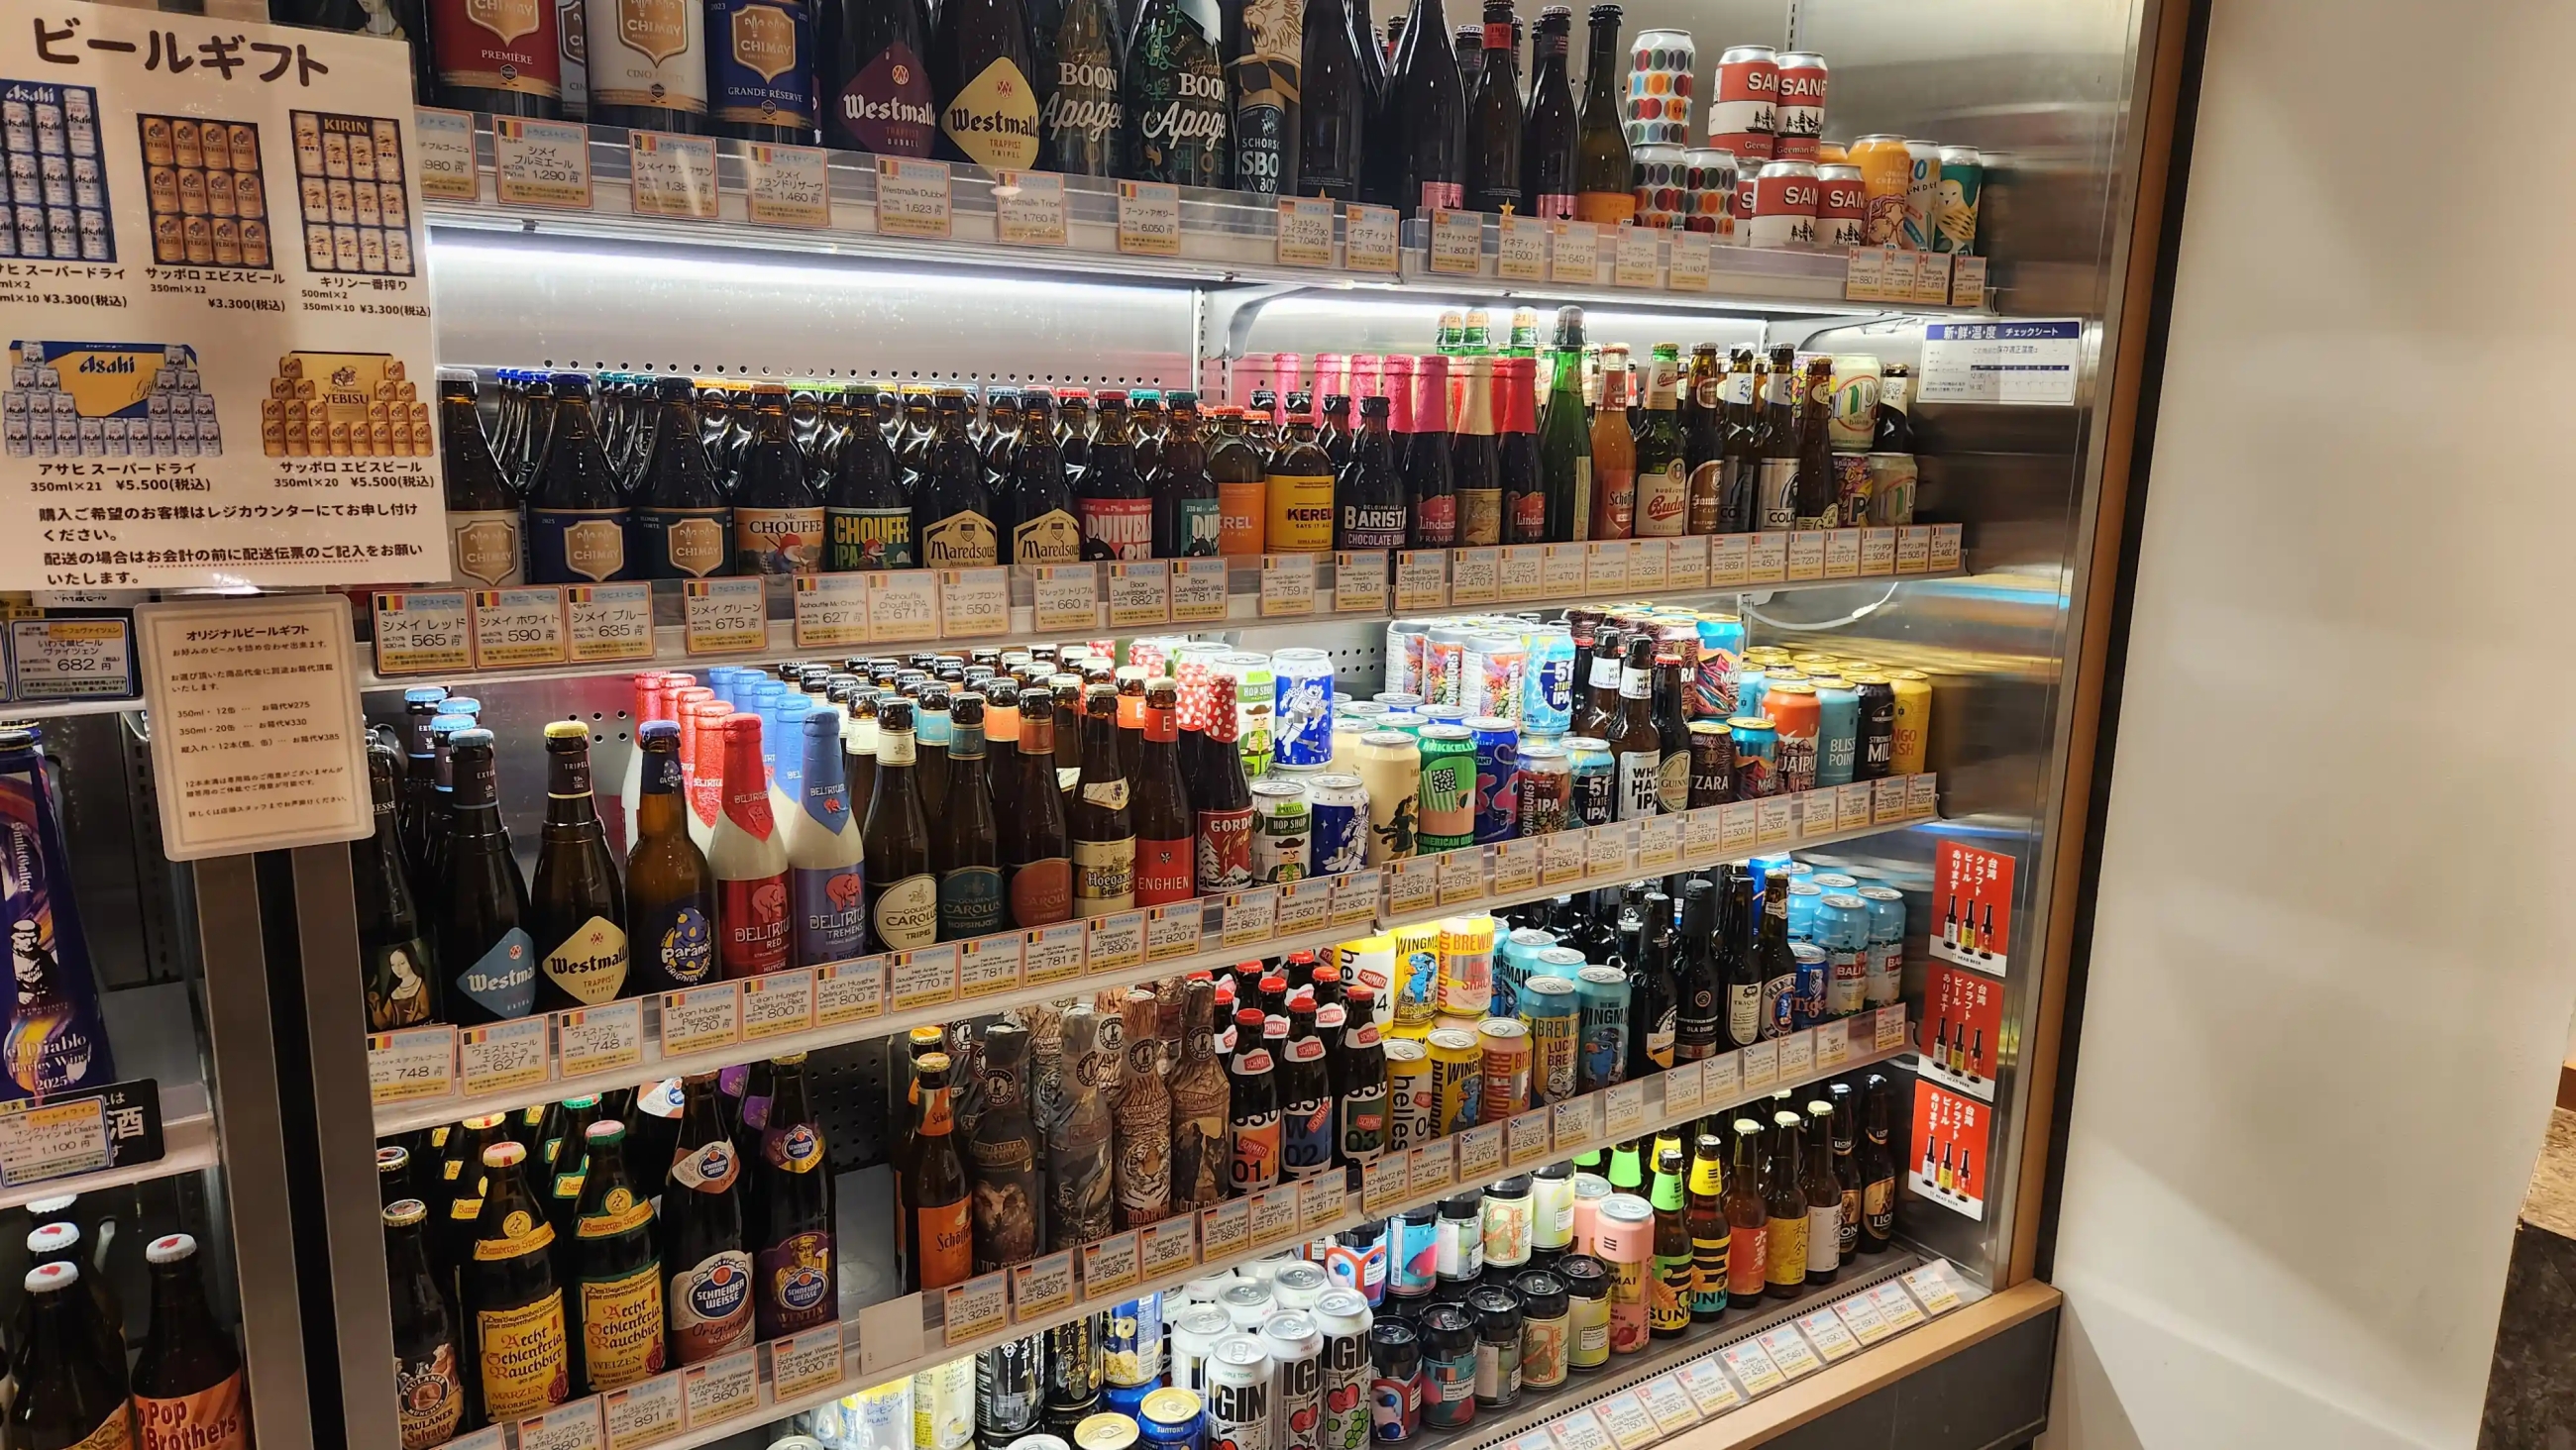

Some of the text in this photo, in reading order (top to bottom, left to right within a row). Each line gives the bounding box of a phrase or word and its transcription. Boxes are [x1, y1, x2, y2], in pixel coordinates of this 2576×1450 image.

[627, 19, 681, 37] CHIMAY
[34, 18, 328, 86] ビールギフト
[741, 40, 791, 55] CHIMAY
[482, 50, 533, 64] PREMIÈRE
[1058, 62, 1117, 91] BOON
[5, 85, 54, 103] Asahi
[728, 87, 803, 102] GRANDE RÉSERVE
[324, 119, 368, 134] KIRIN
[990, 139, 1020, 149] TRAPPIST
[529, 147, 556, 155] シメイ
[776, 170, 800, 179] シメイ
[1515, 251, 1533, 260] 600
[1568, 255, 1584, 263] 649
[26, 265, 125, 279] スーパードライ
[146, 267, 285, 284] サッポロ エビスビール
[320, 276, 407, 290] キリン一番搾り
[79, 356, 134, 373] Asahi
[323, 394, 369, 405] YEBISU
[39, 463, 196, 475] アサヒ スーパードライ
[279, 462, 422, 473] サッポロ エビスビール
[31, 480, 102, 491] 350ml×21
[273, 477, 339, 487] 350ml×20
[40, 503, 417, 522] 購入ご希望のお客様はレジカウンターにてお申し付け
[1287, 507, 1332, 521] KEREL
[1343, 505, 1407, 530] BARISTA
[749, 520, 821, 534] CHOUFFE
[834, 516, 910, 544] CHOUFFE
[43, 528, 117, 543] ください。
[1347, 534, 1390, 545] CHOCOLATE
[44, 544, 423, 566] 配送の場合はお会計の前に配送伝票のご記入をお願い
[467, 551, 512, 563] CHIMAY
[573, 548, 619, 562] CHIMAY
[676, 546, 719, 558] CHIMAY
[931, 541, 995, 561] Maredsous
[834, 549, 859, 569] IPA
[47, 570, 141, 585] いたします。
[1468, 576, 1485, 586] 470
[1514, 574, 1531, 583] 470
[1281, 585, 1300, 596] 759
[1354, 581, 1372, 592] 780
[1414, 580, 1432, 590] 710
[1130, 595, 1152, 606] 682
[1192, 592, 1212, 602] 781
[692, 602, 762, 614] シメイ グリーン
[966, 604, 991, 615] 550
[1058, 599, 1081, 610] 660
[481, 614, 560, 627] シメイ ホワイト
[573, 611, 607, 623] シメイ
[822, 612, 849, 623] 627
[894, 608, 917, 620] 671
[382, 618, 466, 631] シメイ レッド
[715, 616, 745, 630] 675
[186, 625, 309, 641] オリジナルビールギフト
[508, 629, 541, 642] 590
[598, 625, 630, 638] 635
[411, 634, 446, 647] 565
[57, 659, 95, 672] 682
[1555, 661, 1572, 681] 51
[1162, 715, 1171, 732] E
[1830, 738, 1856, 751] BLISS
[565, 762, 588, 771] TRIPEL
[1588, 777, 1609, 796] 51
[1537, 798, 1559, 812] IPA
[1587, 807, 1606, 820] IPA
[1273, 817, 1307, 833] HOP SHOP
[1950, 850, 1961, 890] あります
[1963, 853, 1974, 881] ビール
[1986, 858, 1997, 880] 台湾
[1454, 876, 1472, 887] 979
[1976, 856, 1985, 896] クラフト
[1138, 877, 1189, 890] ENGHIEN
[1406, 884, 1424, 896] 930
[943, 901, 1001, 916] CAROLUS
[1349, 898, 1367, 909] 830
[1296, 907, 1315, 917] 550
[1240, 918, 1261, 929] 860
[906, 929, 931, 940] TRIPEL
[1165, 932, 1187, 943] 820
[766, 938, 782, 949] RED
[1107, 943, 1129, 955] 890
[1046, 957, 1067, 967] 781
[982, 968, 1003, 979] 781
[1358, 971, 1387, 988] SCHMATZ
[584, 975, 615, 989] TRAPPIST
[915, 979, 940, 989] 770
[840, 992, 866, 1004] 800
[767, 1006, 794, 1018] 800
[571, 1022, 631, 1038] ウェストマール
[692, 1020, 719, 1033] 730
[24, 1034, 87, 1057] Diablo
[472, 1040, 538, 1057] ウェストマール
[590, 1039, 620, 1052] 748
[493, 1056, 523, 1072] 627
[396, 1067, 429, 1080] 748
[36, 1075, 67, 1090] 2025
[1309, 1102, 1331, 1131] SCHMATZ
[1357, 1116, 1382, 1129] SCHMATZ
[80, 1140, 90, 1149] 円
[1239, 1139, 1268, 1156] SCHMATZ
[1522, 1137, 1537, 1147] 630
[1475, 1152, 1492, 1162] 470
[1425, 1167, 1441, 1179] 427
[1379, 1181, 1397, 1192] 622
[1316, 1198, 1335, 1210] 517
[1266, 1214, 1285, 1226] 517
[1160, 1248, 1181, 1260] 880
[1104, 1266, 1125, 1278] 880
[697, 1279, 744, 1300] SCHNEIDER
[788, 1283, 821, 1296] SCHNEIDER
[794, 1291, 817, 1300] WEISSE
[1036, 1287, 1058, 1299] 880
[705, 1293, 739, 1309] WEISSE
[602, 1297, 648, 1321] Aecht
[968, 1307, 991, 1321] 328
[501, 1325, 548, 1349] Aecht
[591, 1320, 660, 1350] Rauchbier
[489, 1347, 562, 1380] Rauchbier
[593, 1355, 641, 1370] WEIZEN
[799, 1361, 824, 1376] 900
[711, 1388, 739, 1402] 860
[148, 1400, 187, 1427] Pop
[401, 1408, 453, 1431] PAULANER
[634, 1411, 660, 1428] 891
[149, 1416, 237, 1450] Brothers
